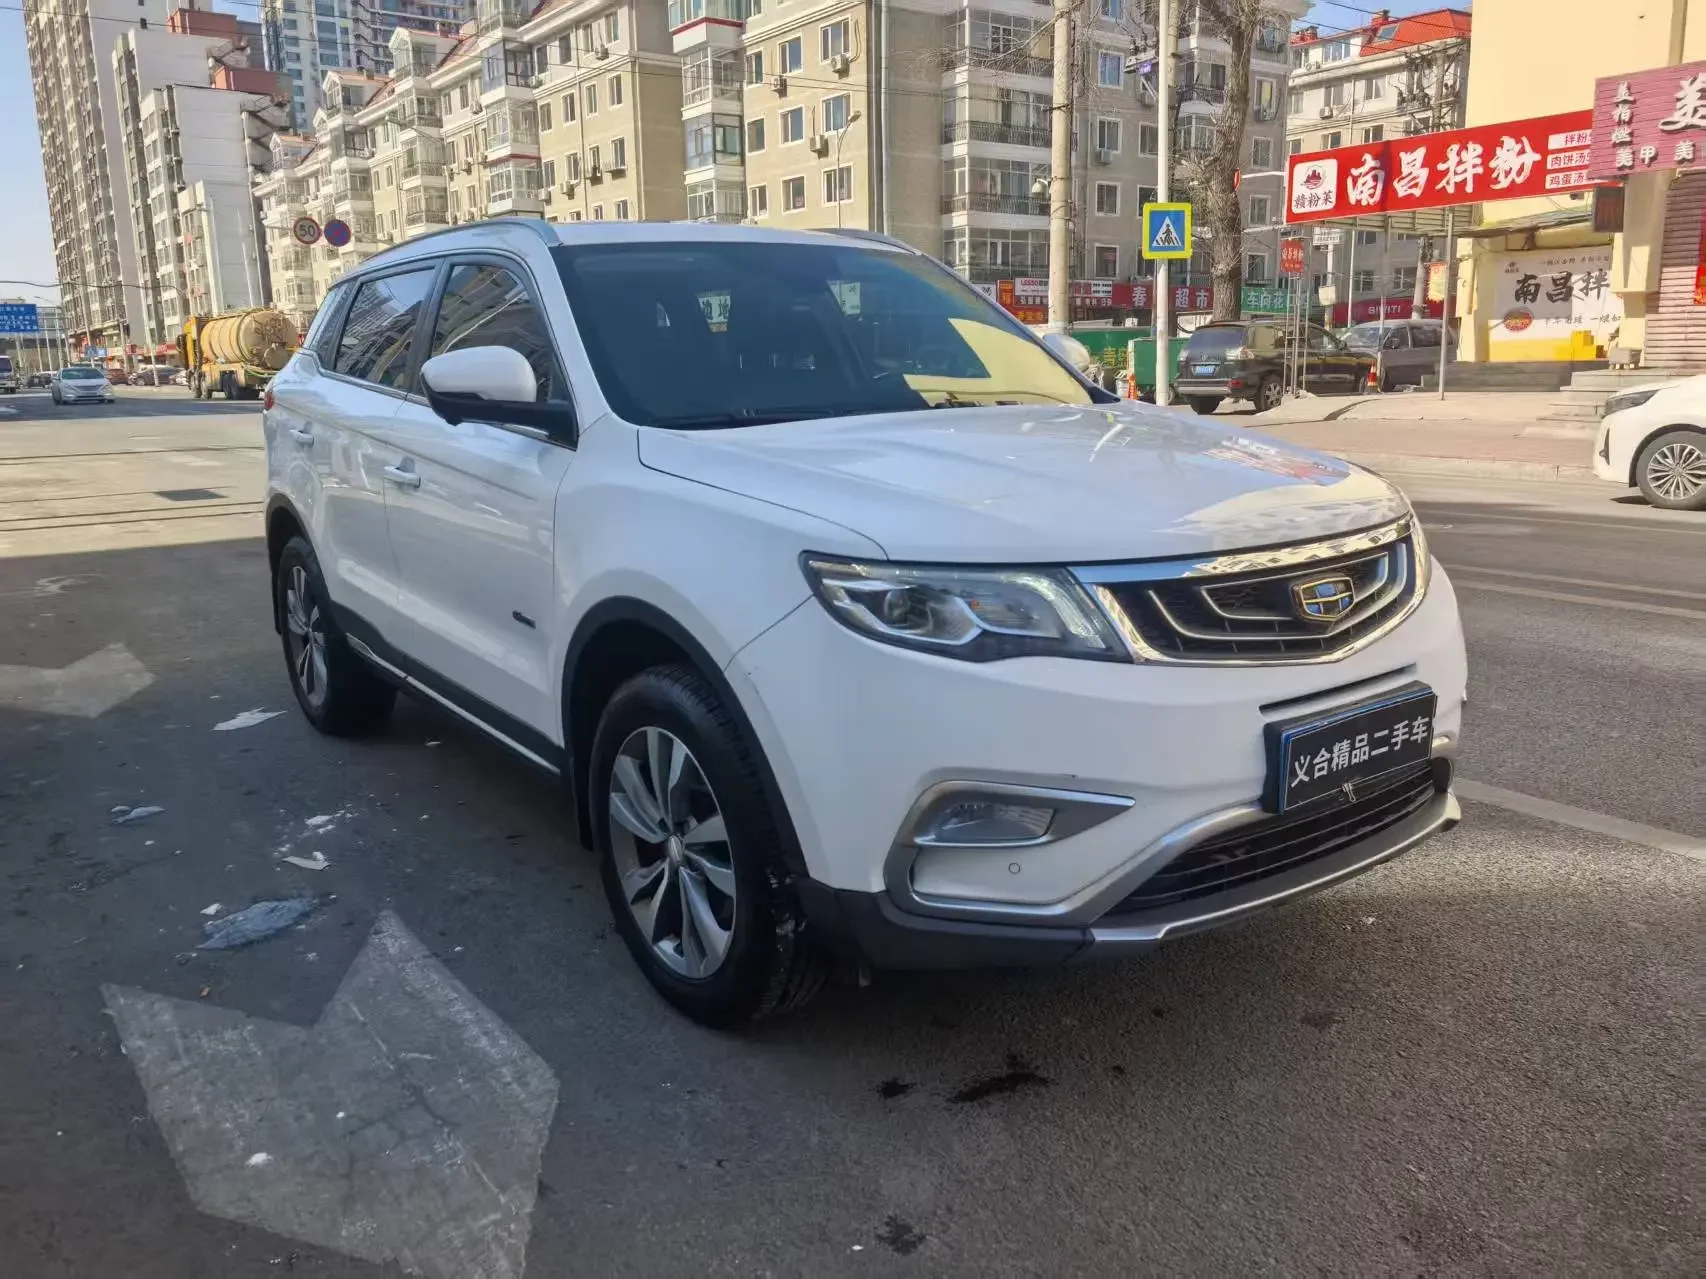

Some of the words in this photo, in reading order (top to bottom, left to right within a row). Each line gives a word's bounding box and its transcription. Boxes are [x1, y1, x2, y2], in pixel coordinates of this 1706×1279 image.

[1347, 135, 1541, 206] 南昌拌粉
[299, 224, 315, 237] 50
[1291, 716, 1430, 788] 义合精品二手车
